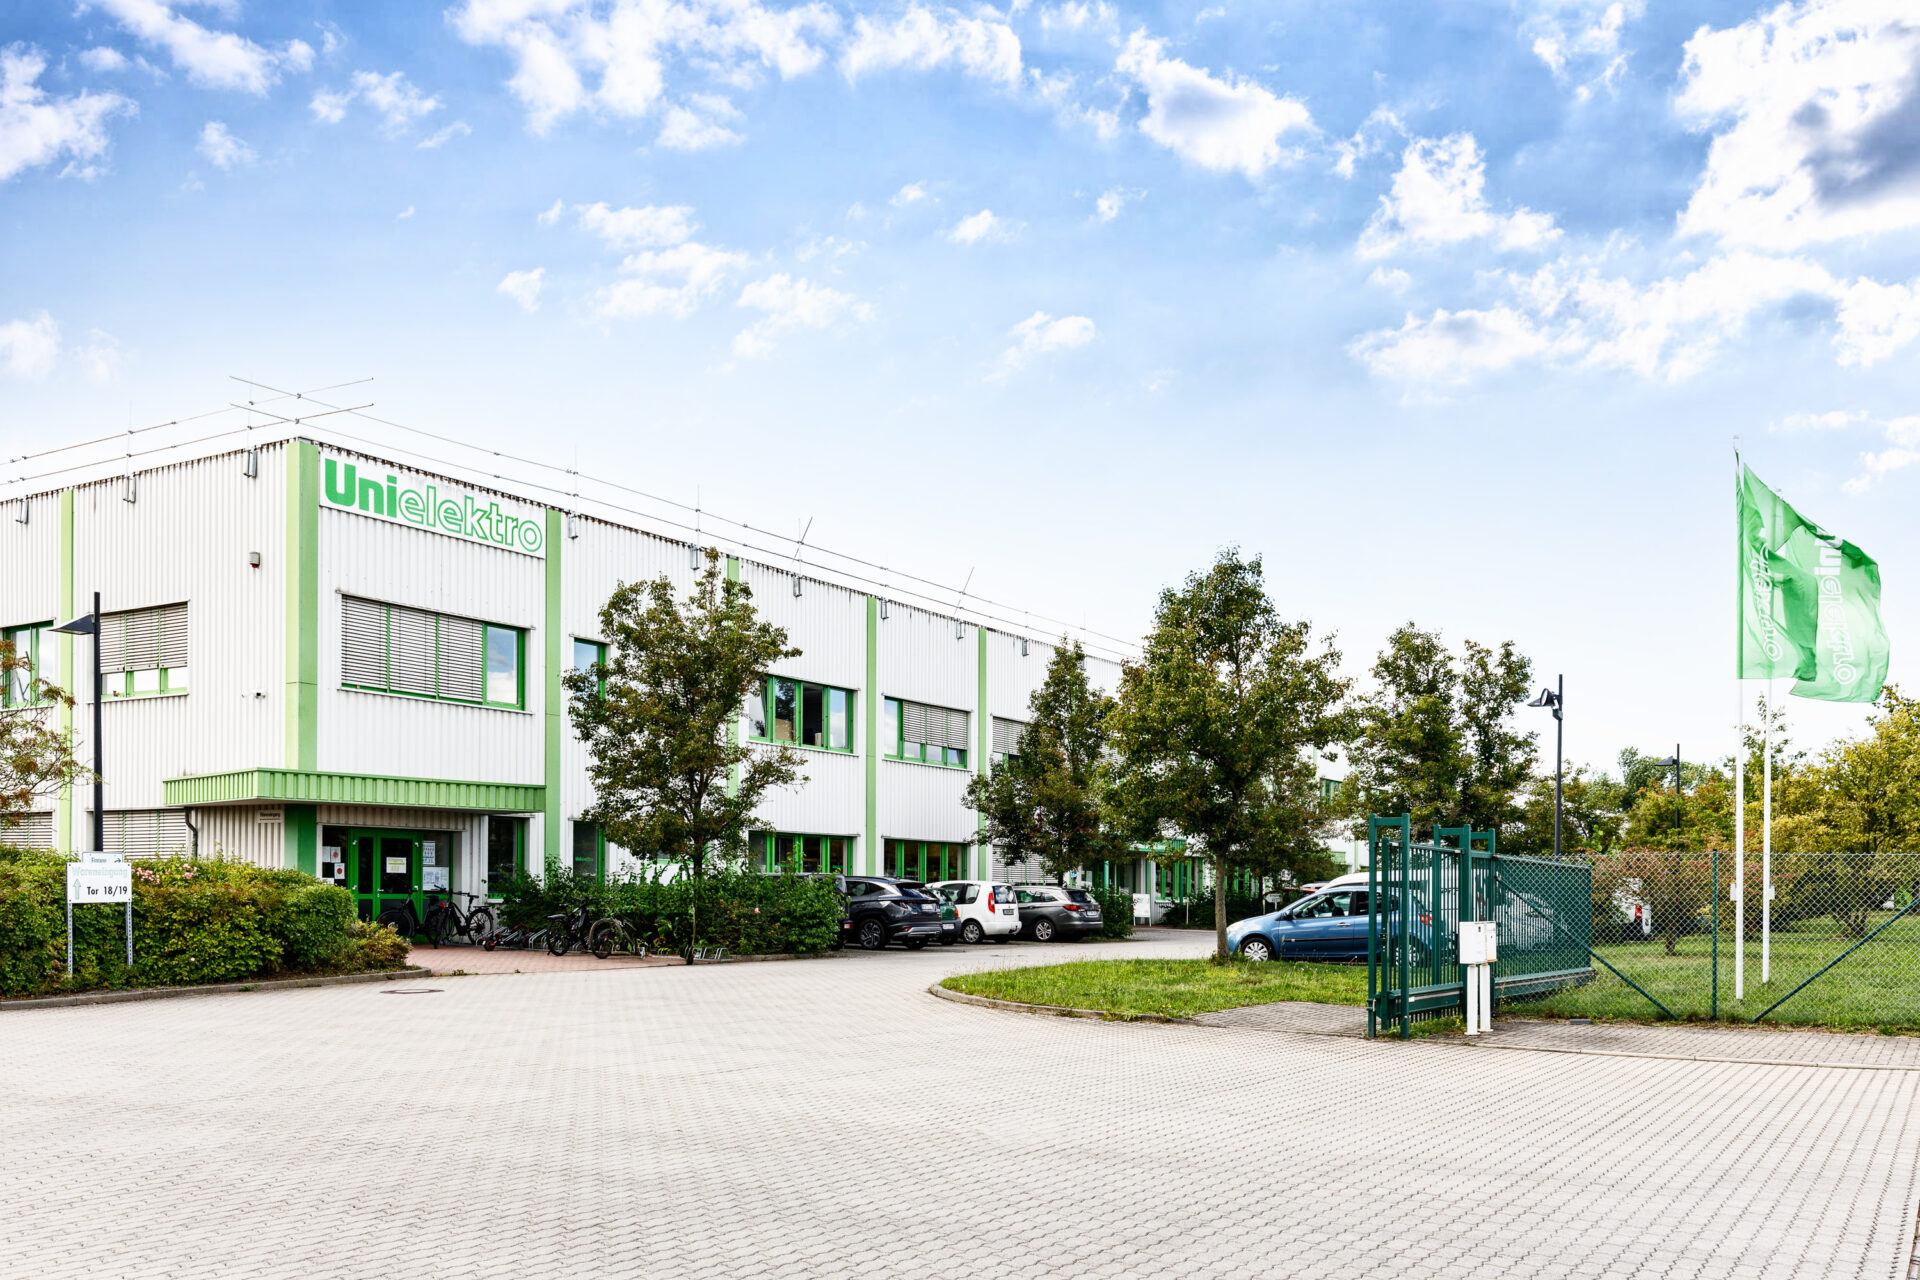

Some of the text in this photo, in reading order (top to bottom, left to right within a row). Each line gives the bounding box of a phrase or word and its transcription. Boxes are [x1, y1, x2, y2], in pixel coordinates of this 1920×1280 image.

[325, 458, 543, 552] Unielektro
[86, 885, 128, 896] Tor 18/19
